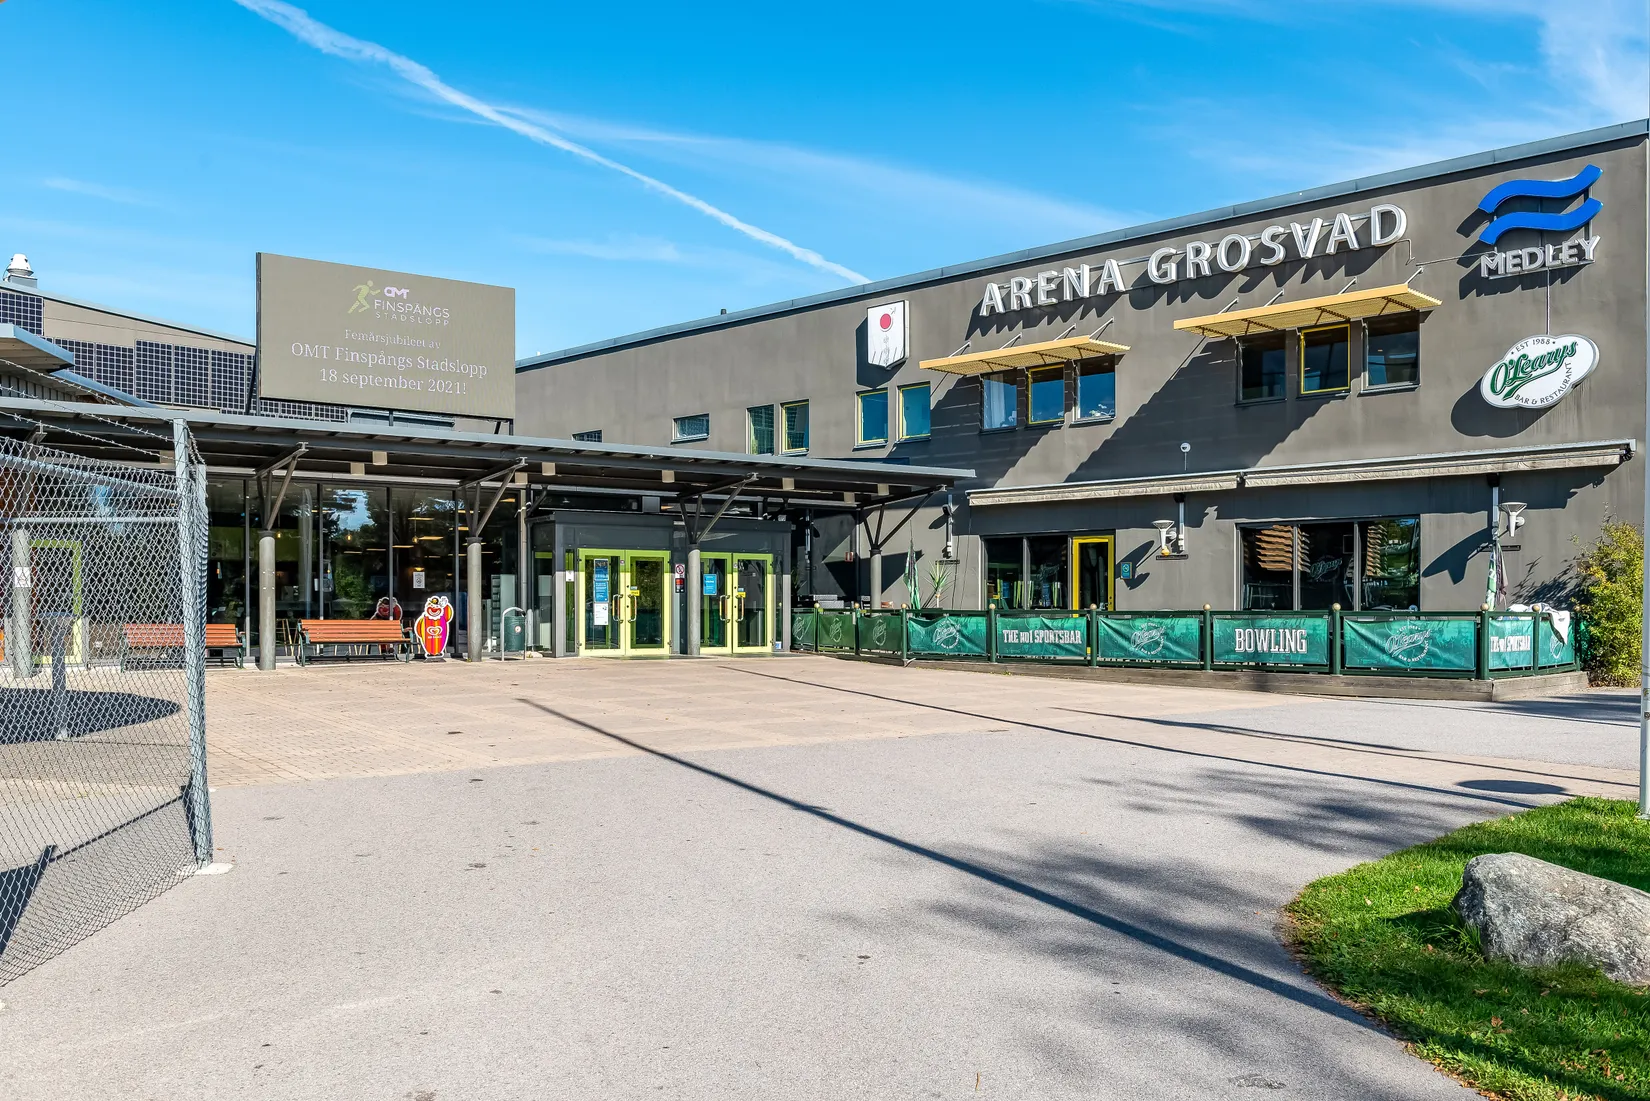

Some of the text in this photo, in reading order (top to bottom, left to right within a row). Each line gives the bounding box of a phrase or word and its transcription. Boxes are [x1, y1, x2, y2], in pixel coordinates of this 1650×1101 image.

[979, 203, 1408, 316] ARENA GROSVAD
[1480, 235, 1601, 278] MEDLEY
[383, 286, 410, 299] OMT
[374, 299, 450, 318] FINSPÅNGS
[375, 311, 449, 326] STADSLOPP
[1515, 341, 1530, 353] EST
[291, 342, 488, 379] OMT Finspångs Stadslopp
[320, 368, 467, 395] 18 september 2021!
[1514, 394, 1530, 405] BAR
[1540, 362, 1573, 404] RESTAURANT
[1002, 629, 1019, 644] THE
[1034, 629, 1082, 645] SPORTSBAR
[1234, 628, 1308, 654] BOWLING
